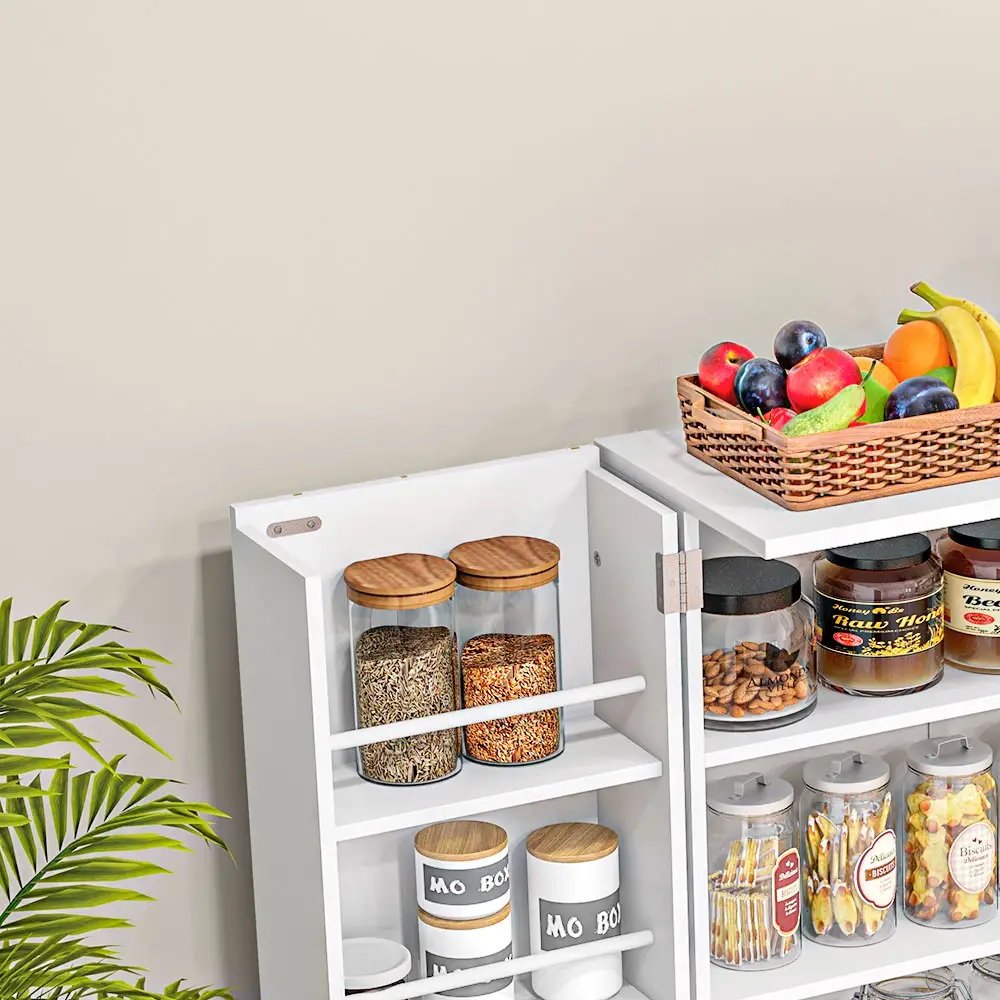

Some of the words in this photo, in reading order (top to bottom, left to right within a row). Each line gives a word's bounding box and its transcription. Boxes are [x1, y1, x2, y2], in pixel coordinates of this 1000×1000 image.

[832, 603, 871, 616] Honey
[832, 614, 889, 630] Raw
[959, 842, 993, 857] Biscuits
[429, 875, 466, 895] MO
[546, 913, 583, 939] MO
